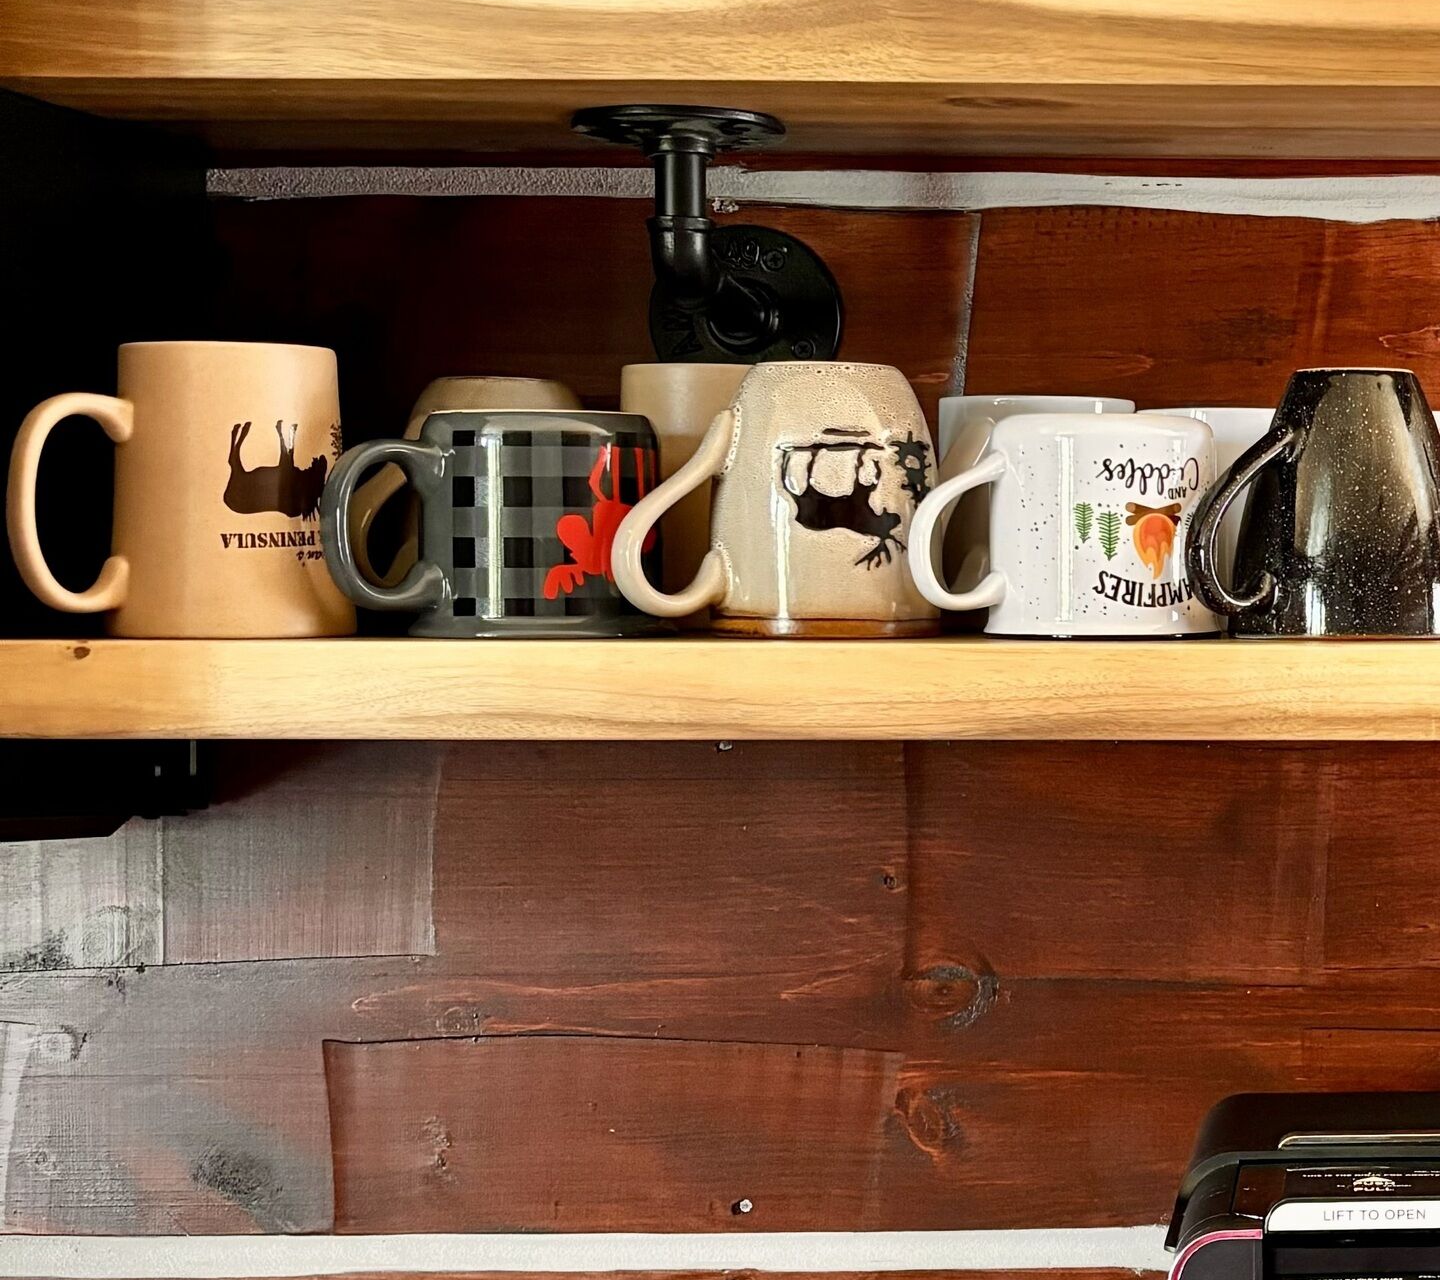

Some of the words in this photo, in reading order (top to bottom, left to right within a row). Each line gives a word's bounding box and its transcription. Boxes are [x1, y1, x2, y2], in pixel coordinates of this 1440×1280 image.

[1167, 486, 1188, 500] AND
[220, 530, 316, 550] PENINSULA
[1092, 570, 1194, 608] AMPFIRES
[1323, 1209, 1354, 1222] LIFT
[1359, 1209, 1380, 1221] TO
[1384, 1209, 1427, 1221] OPEN
